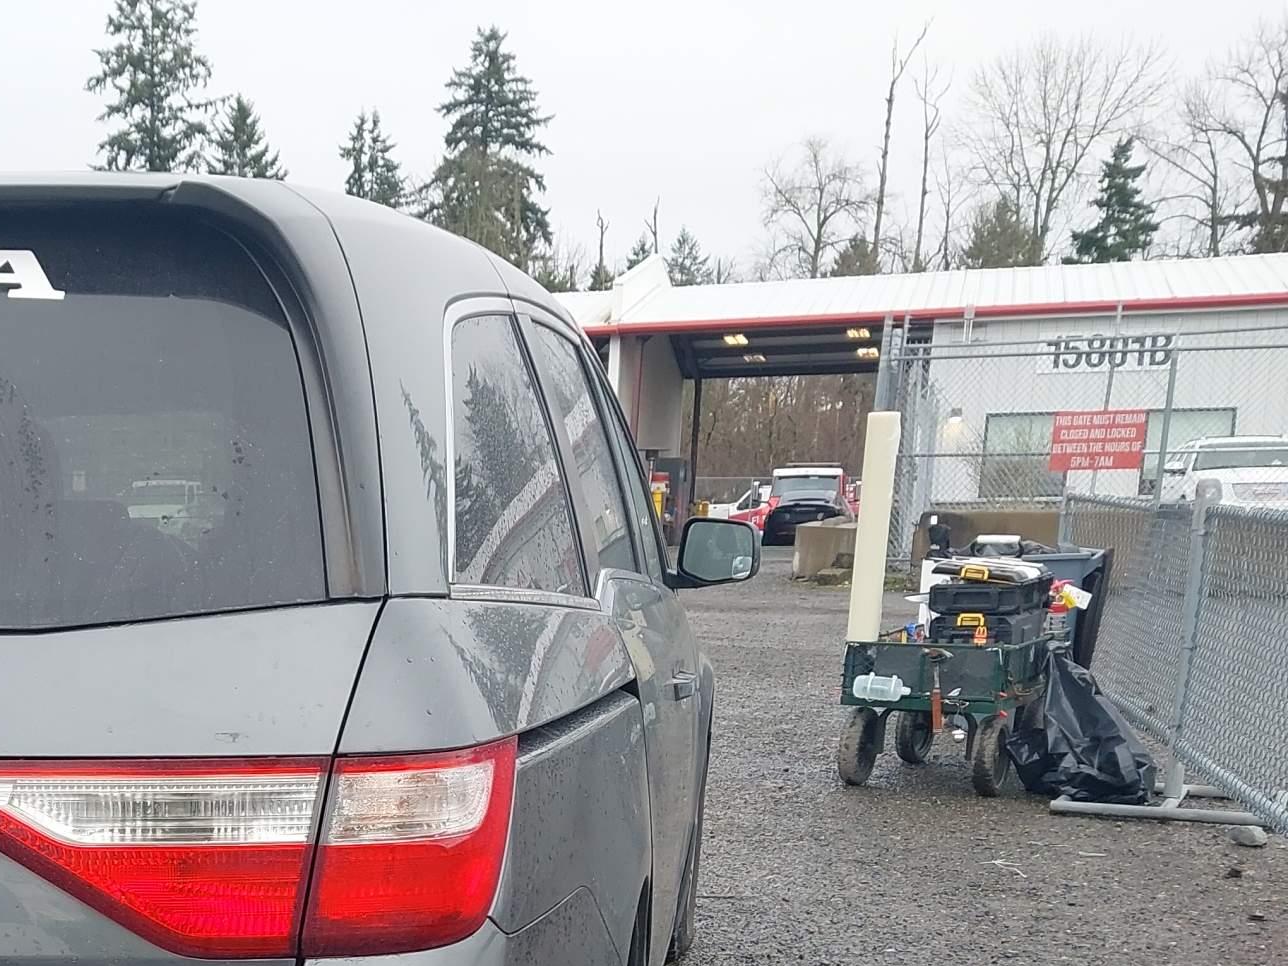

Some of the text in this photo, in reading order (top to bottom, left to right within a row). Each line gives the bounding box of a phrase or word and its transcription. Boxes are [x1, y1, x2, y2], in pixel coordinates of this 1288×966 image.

[1047, 332, 1173, 369] 15801B
[1055, 413, 1146, 426] THIS GATE MUST REMAIN
[1060, 427, 1137, 440] CLOSED AND LOCKED
[1052, 441, 1143, 454] BETWEEN THE HOURS OF
